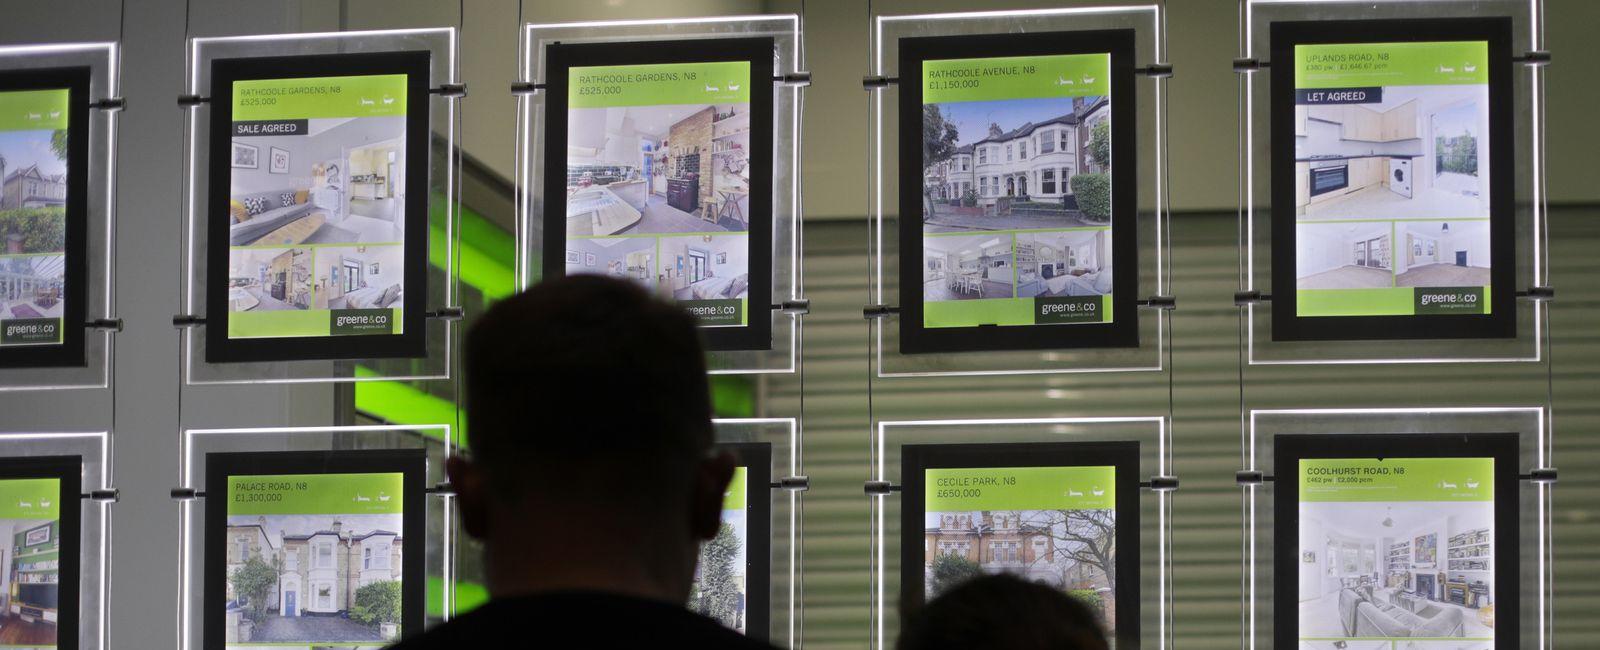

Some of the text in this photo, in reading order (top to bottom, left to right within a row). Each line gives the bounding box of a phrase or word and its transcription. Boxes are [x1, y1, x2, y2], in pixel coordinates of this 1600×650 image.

[1306, 52, 1390, 63] UPLANDS ROAD, N8
[579, 72, 697, 84] RATHCOOLE GARDENS, N8
[929, 66, 1036, 79] RATHCOOLE AVENUE, N8
[929, 80, 980, 90] £1,150,000
[240, 86, 341, 96] RATHCOOLE GARDENS, N8
[578, 86, 622, 96] £525,000
[1307, 91, 1366, 102] LET AGREED
[240, 98, 277, 106] £525,000
[238, 123, 297, 134] SALE AGREED
[1421, 294, 1476, 305] greene&co
[687, 306, 736, 315] reene&co
[1042, 302, 1096, 314] greene&co
[336, 315, 386, 326] greene&co
[6, 324, 54, 336] greene&co
[1306, 467, 1405, 476] COOLHURST ROAD, N8
[236, 482, 308, 492] PALACE ROAD, N8
[937, 476, 1016, 487] CECILE PARK, N8
[236, 494, 282, 502] £1,300,000
[937, 489, 980, 498] £650,000
